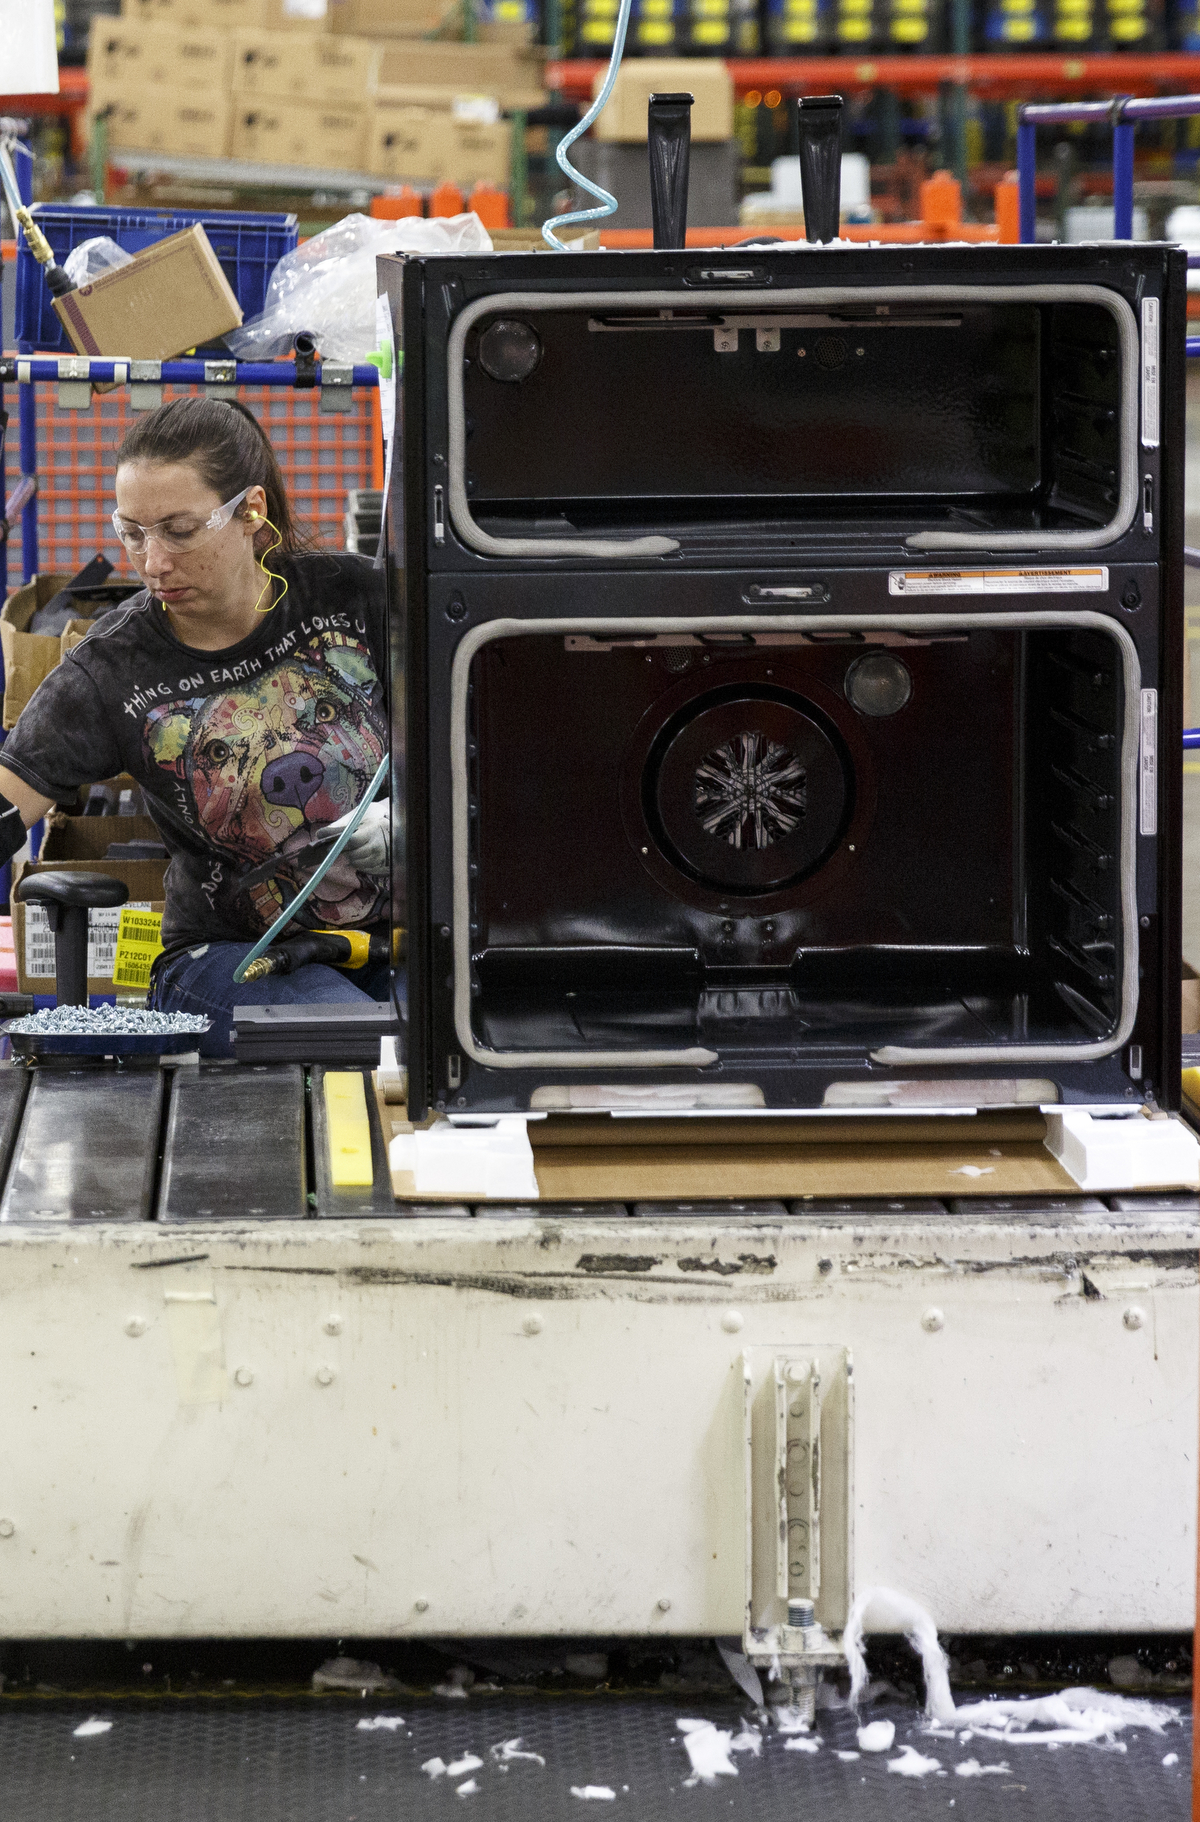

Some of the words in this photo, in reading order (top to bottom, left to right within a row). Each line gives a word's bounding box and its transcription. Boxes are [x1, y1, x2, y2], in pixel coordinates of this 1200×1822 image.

[179, 674, 205, 692] ON
[210, 659, 262, 683] EARTH
[265, 630, 297, 661] THAT
[301, 613, 351, 635] LOVES
